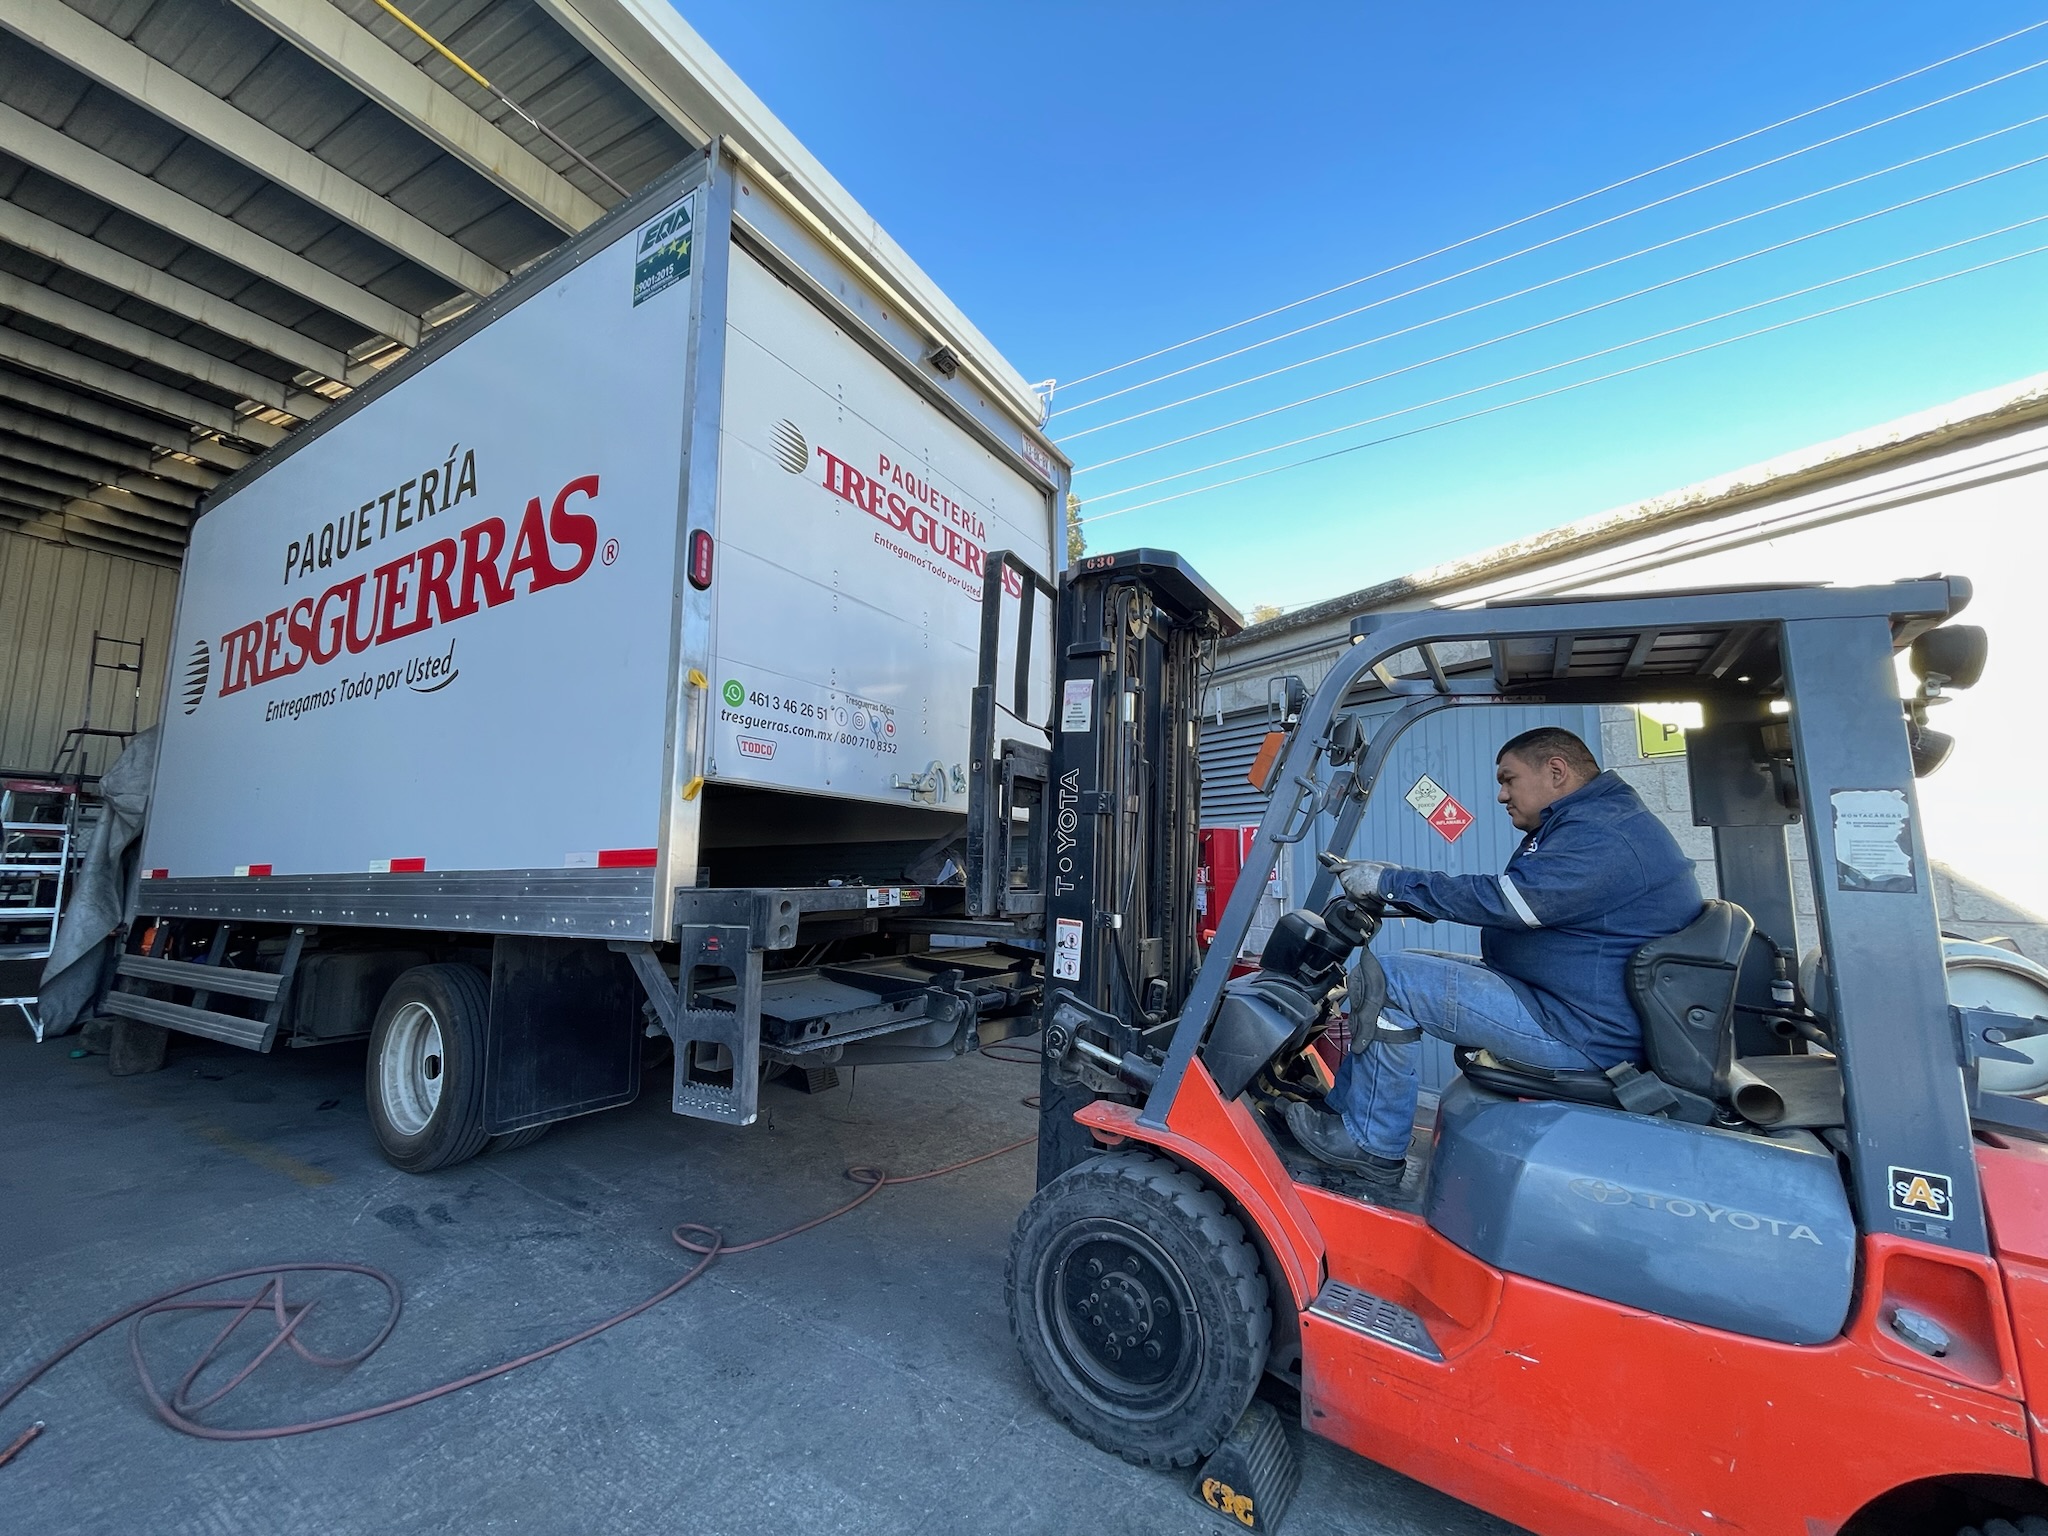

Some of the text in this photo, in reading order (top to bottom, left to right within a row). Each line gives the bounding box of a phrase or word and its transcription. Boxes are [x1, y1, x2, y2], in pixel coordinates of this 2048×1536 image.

[284, 442, 477, 585] PAQUETERÍA
[817, 445, 1022, 600] TRESGUERAS
[879, 453, 986, 543] PAQUETERÍA
[218, 474, 600, 698] TRESGUERRAS
[874, 532, 982, 598] Entregamos Todo por Usted
[1087, 555, 1115, 570] 630
[265, 638, 456, 723] Entregamos Todo por Usted
[749, 691, 828, 721] 461 3 46 26 51
[721, 708, 898, 755] tresguerras.com.mx / 800 710 8352
[741, 740, 772, 756] TODCO
[1639, 1194, 1823, 1246] TOYOTA
